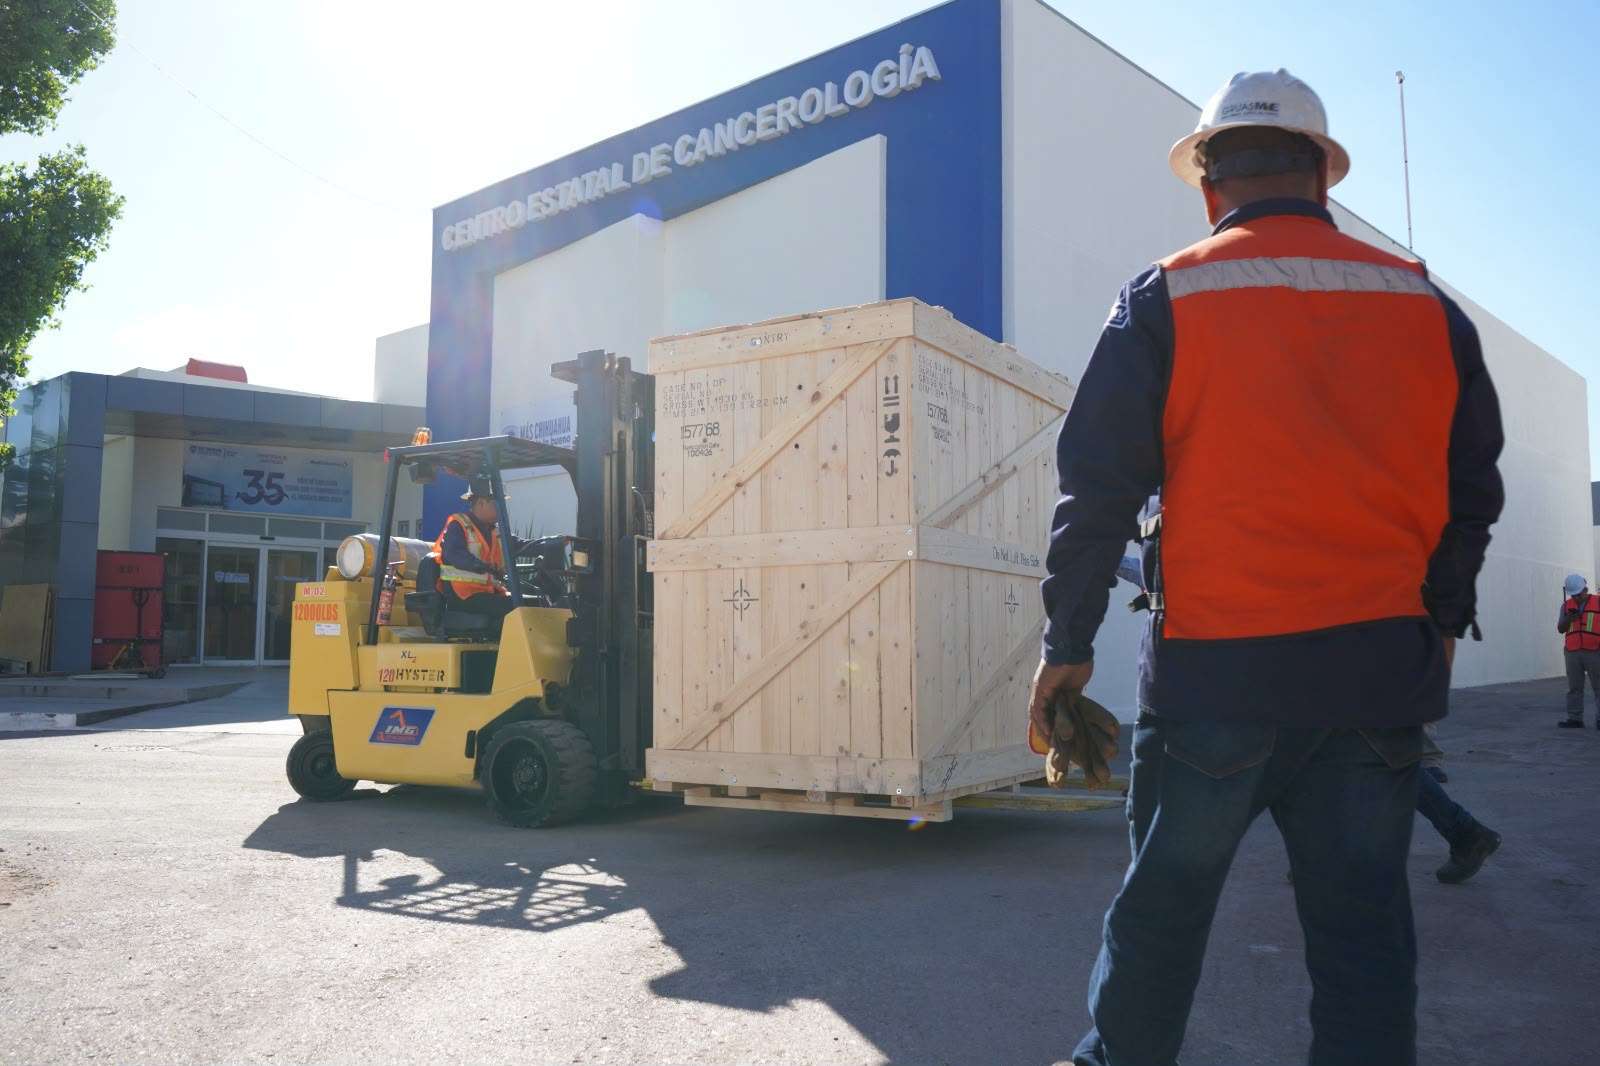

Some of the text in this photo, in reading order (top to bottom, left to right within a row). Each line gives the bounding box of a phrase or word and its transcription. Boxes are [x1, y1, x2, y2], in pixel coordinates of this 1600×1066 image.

[442, 43, 941, 251] CENTRO ESTATAL DE CANCEROLOGÍA
[239, 468, 289, 505] 35
[295, 603, 338, 621] 12000LBS
[378, 668, 445, 682] 120 HYSTER
